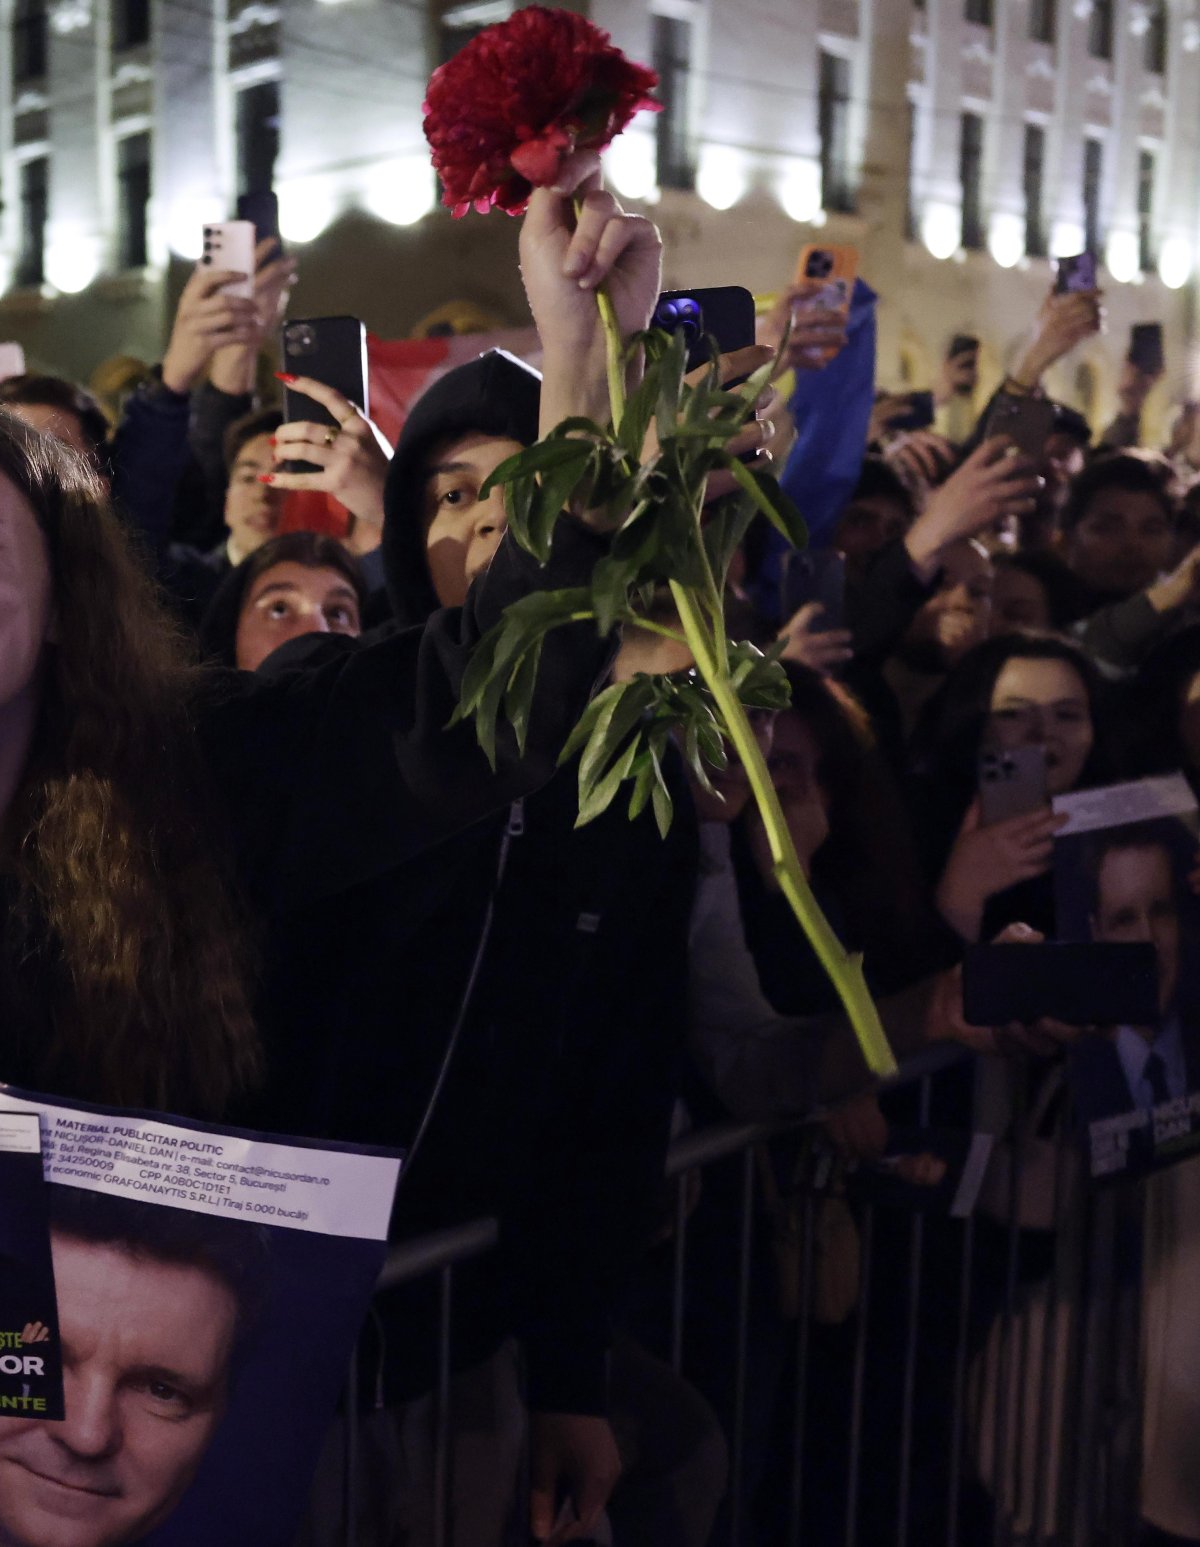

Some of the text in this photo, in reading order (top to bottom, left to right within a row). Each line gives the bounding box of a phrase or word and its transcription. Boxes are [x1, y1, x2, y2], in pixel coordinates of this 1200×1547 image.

[56, 1118, 110, 1134] MATERIAL
[113, 1126, 178, 1147] PUBLICITAR
[180, 1140, 224, 1156] POLITIC
[57, 1154, 114, 1171] 34250009
[59, 1143, 76, 1154] Bd.
[77, 1145, 112, 1159] Regina
[114, 1151, 160, 1170] Elisabeta
[194, 1168, 227, 1182] Sector
[149, 1146, 174, 1159] DAN
[139, 1169, 162, 1181] CPP
[53, 1166, 102, 1181] economic
[103, 1174, 187, 1199] GRAFOANAYTIS
[222, 1197, 243, 1211] Tiraj
[245, 1202, 276, 1215] 5.000
